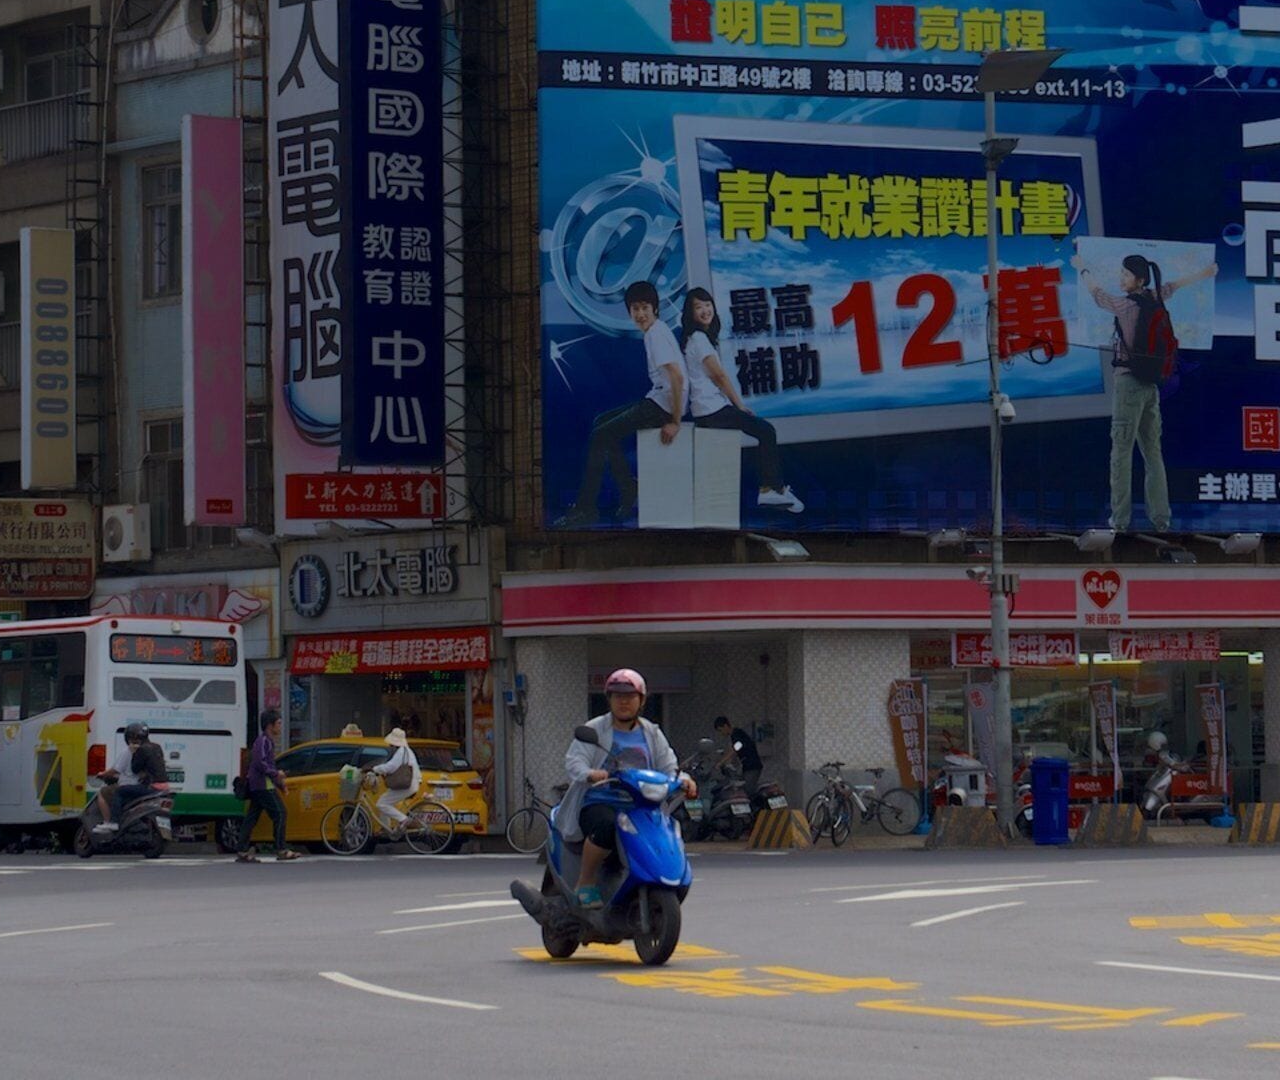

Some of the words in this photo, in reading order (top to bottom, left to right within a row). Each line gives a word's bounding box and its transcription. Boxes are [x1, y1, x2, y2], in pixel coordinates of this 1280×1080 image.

[874, 5, 1048, 52] 照亮前程
[728, 284, 816, 336] 最高
[734, 344, 822, 397] 補助
[336, 543, 461, 597] 北太電腦
